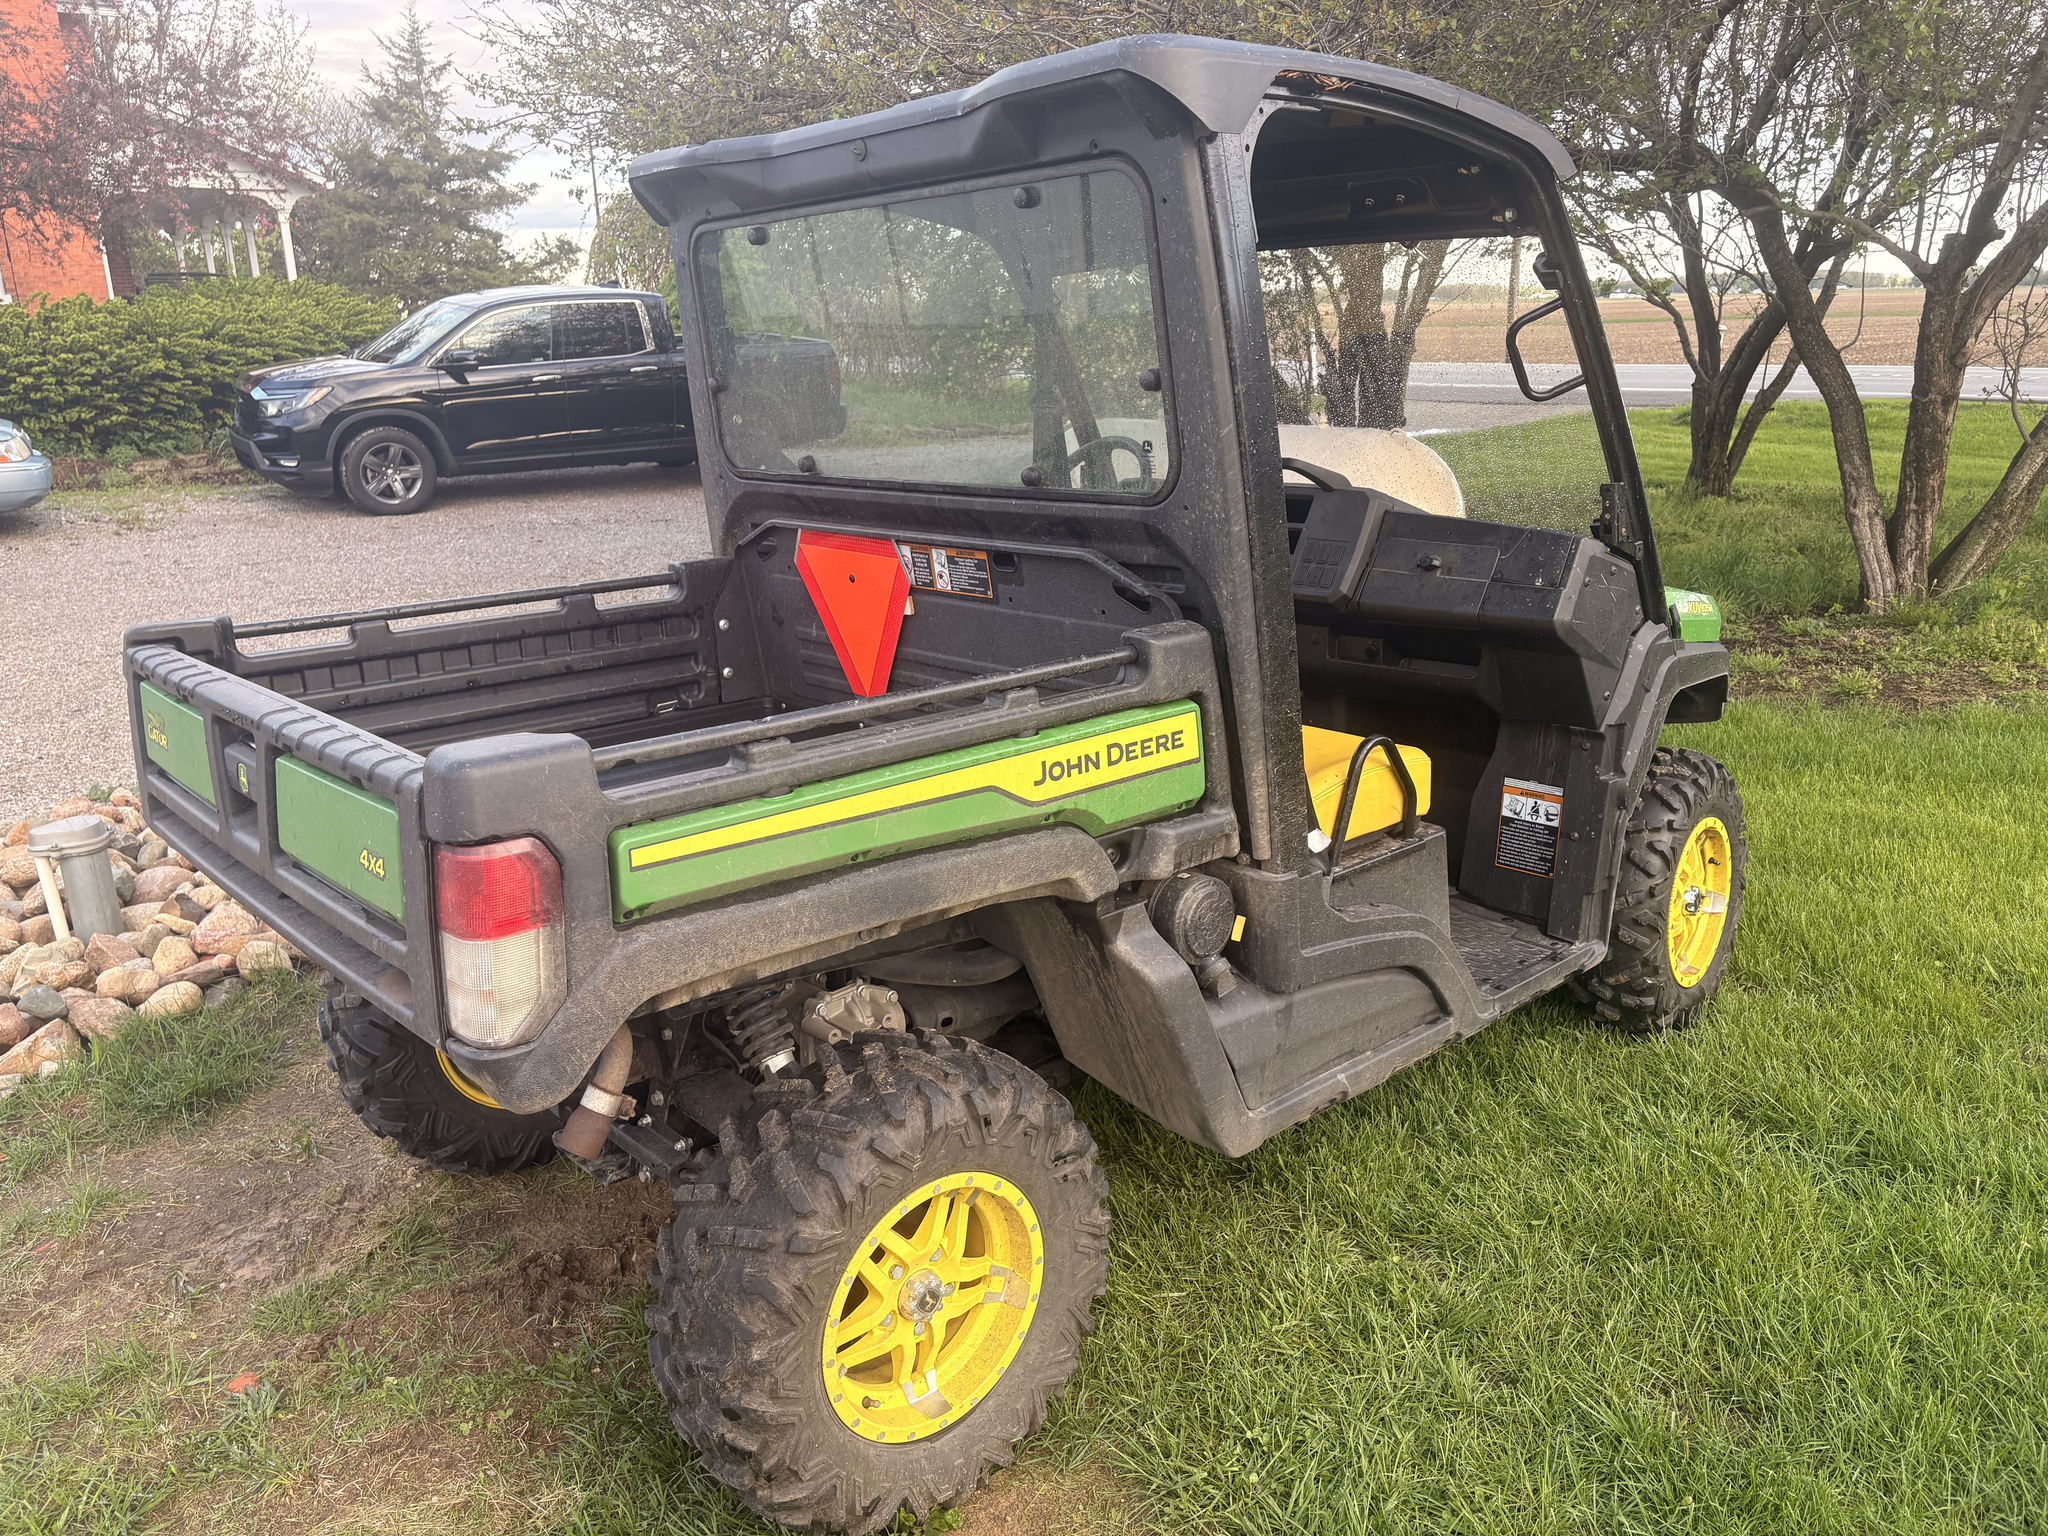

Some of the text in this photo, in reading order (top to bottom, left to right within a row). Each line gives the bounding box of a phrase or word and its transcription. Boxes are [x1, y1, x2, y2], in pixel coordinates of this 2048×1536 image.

[148, 722, 168, 751] GATOR
[1033, 729, 1185, 787] JOHN DEERE
[1525, 791, 1546, 800] WARNING
